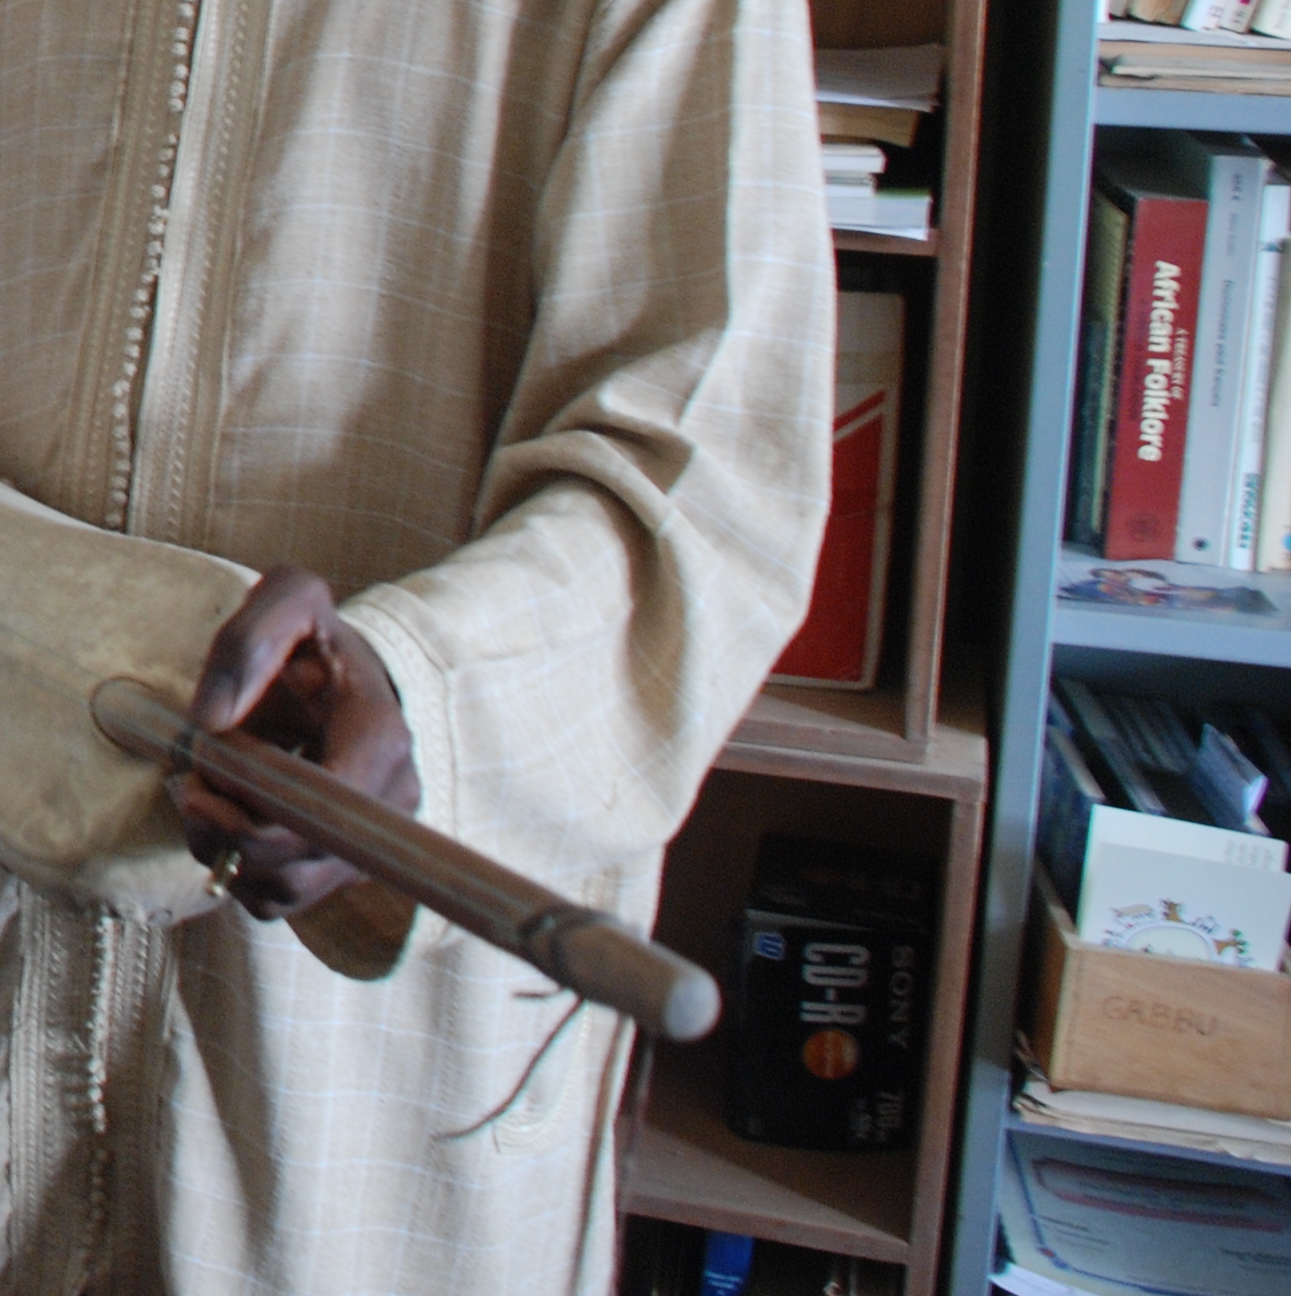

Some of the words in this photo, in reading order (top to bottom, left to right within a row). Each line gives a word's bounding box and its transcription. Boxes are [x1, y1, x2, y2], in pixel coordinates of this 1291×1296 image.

[1146, 260, 1182, 354] African
[1135, 356, 1174, 462] Folklore
[797, 939, 872, 1027] CD-R
[884, 943, 916, 1050] SONY
